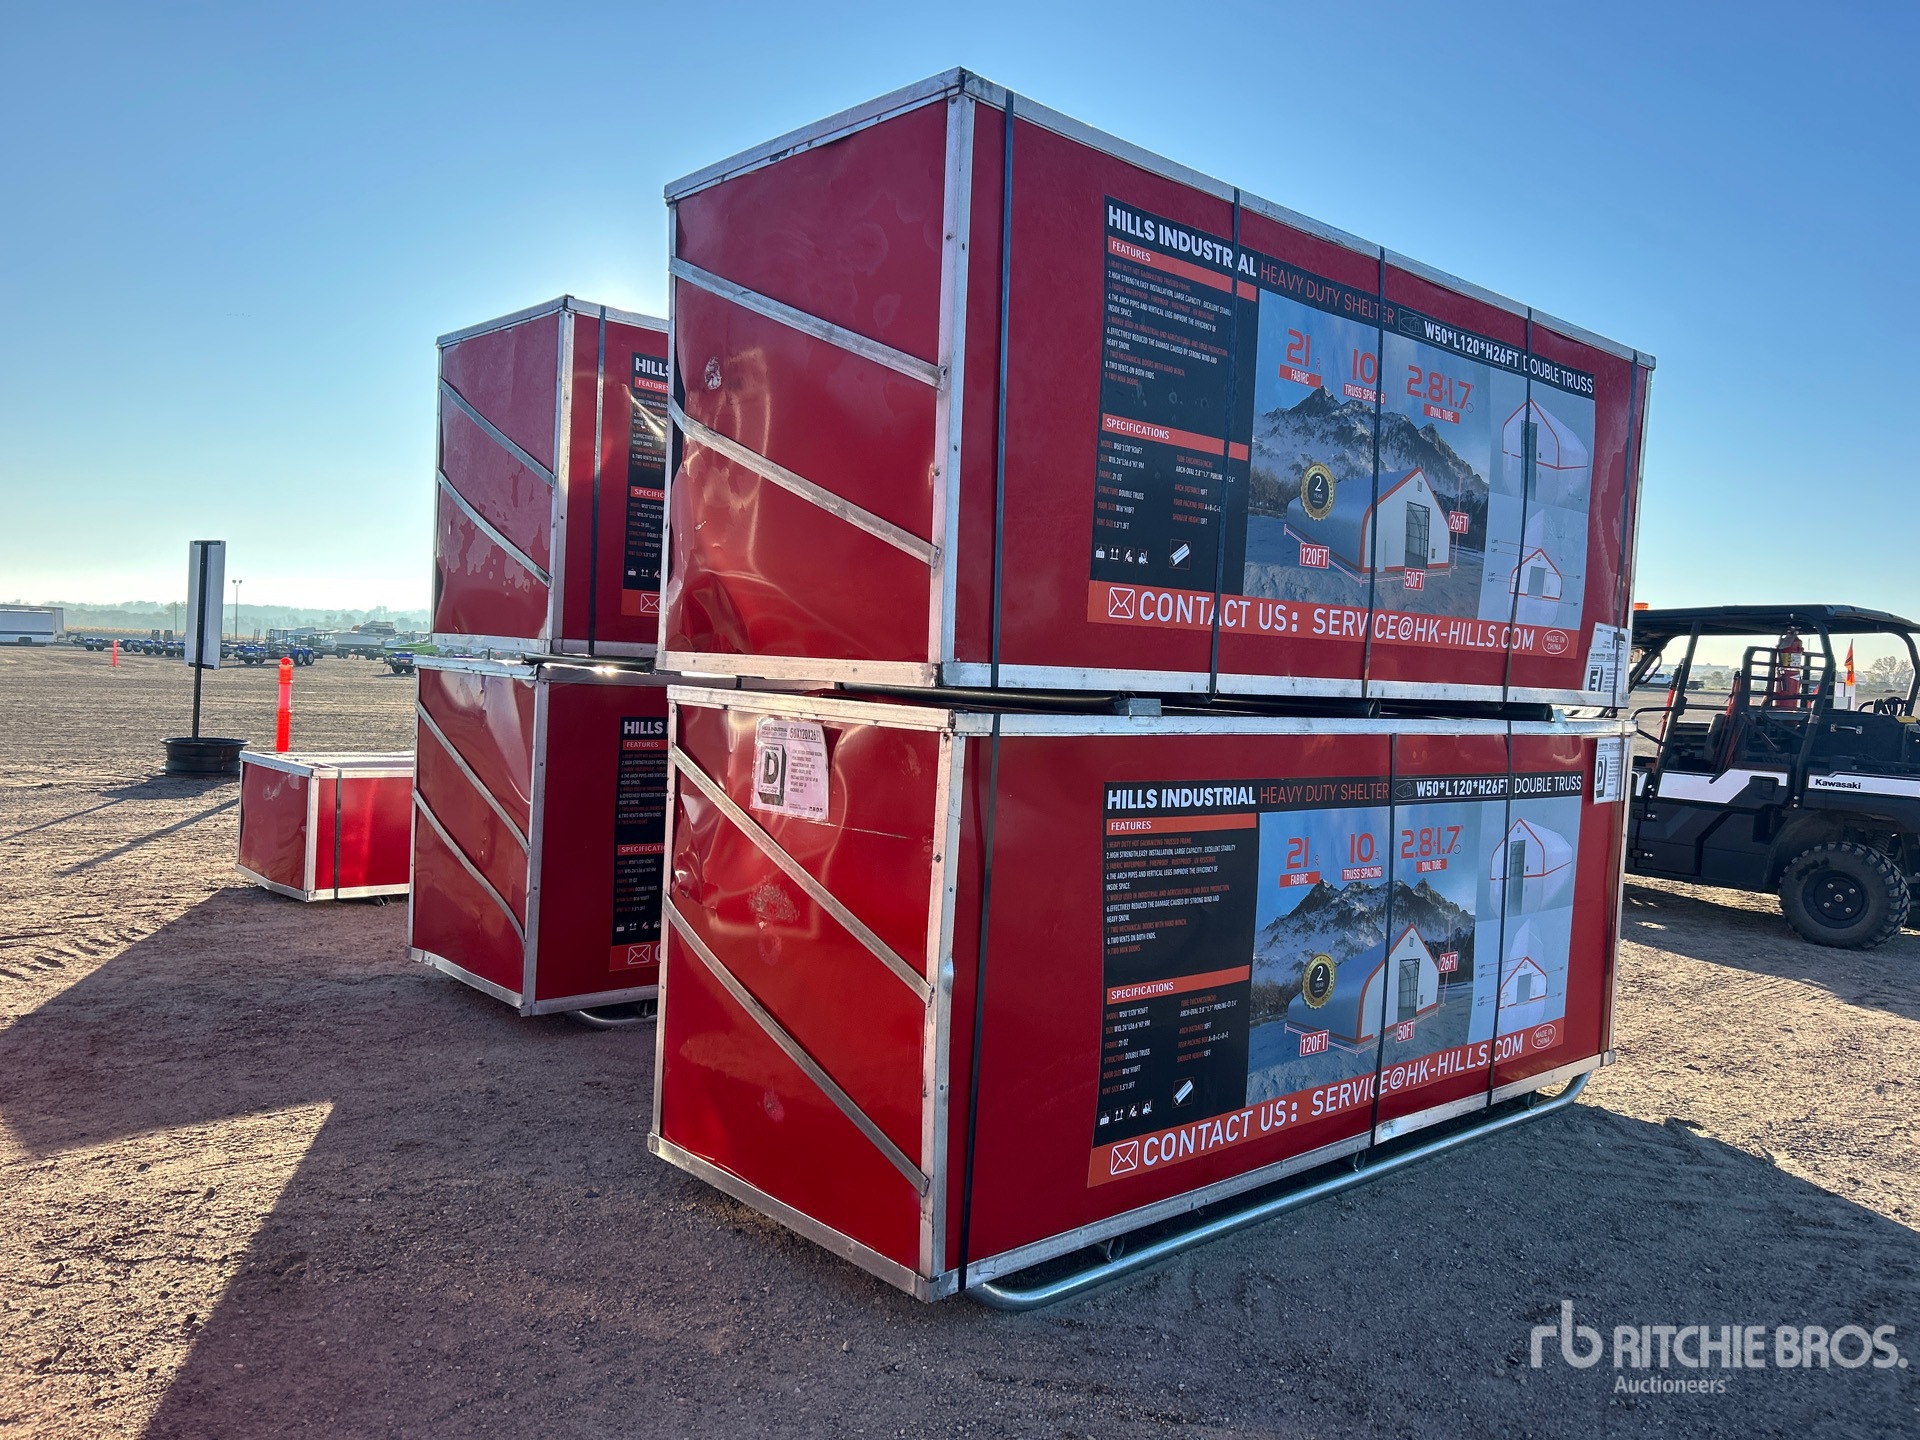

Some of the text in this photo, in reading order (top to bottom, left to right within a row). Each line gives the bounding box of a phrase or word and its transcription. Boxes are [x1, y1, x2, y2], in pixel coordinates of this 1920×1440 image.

[1112, 240, 1150, 262] FEATURES
[1107, 303, 1120, 313] INSIDE
[1108, 205, 1155, 241] HILLS
[1158, 223, 1257, 277] INDUSTRAL
[1260, 261, 1303, 294] HEAVY
[1306, 278, 1340, 308] DUTY
[1560, 368, 1593, 394] TRUSS
[1119, 296, 1129, 305] ARCH
[1129, 299, 1139, 308] PIPES
[1147, 305, 1163, 316] VERTICAL
[1173, 313, 1187, 323] IMPROVE
[1106, 337, 1117, 347] HEAVY
[1132, 333, 1148, 344] REDUCED
[1155, 340, 1169, 350] DAMAGE
[1170, 344, 1182, 354] CAUSED
[1188, 350, 1201, 359] STRONG
[1286, 327, 1310, 367] 21
[1117, 363, 1128, 373] VENTS
[1128, 366, 1134, 374] ON
[1135, 368, 1144, 377] BOTH
[1352, 347, 1378, 386] 10
[1291, 369, 1309, 384] FABIRC
[1344, 383, 1384, 404] TRUSS SPACG
[1430, 405, 1453, 422] OVAL TUBE
[1106, 418, 1169, 440] SPECIFICATIONS
[1315, 475, 1322, 491] 2
[1450, 513, 1467, 532] 26FT
[1301, 546, 1327, 566] 120FT
[1405, 571, 1423, 588] 50FT
[1138, 590, 1534, 651] CONTACT US: SERVCE@HK-HILLS.COM
[1547, 642, 1561, 650] CHINA
[624, 721, 664, 735] HILLS
[763, 751, 779, 784] D
[1107, 789, 1157, 809] HILLS
[1161, 786, 1256, 808] INDUSTRIAL
[1259, 785, 1303, 804] HEAVY
[1306, 784, 1337, 801] DUTY
[1340, 783, 1389, 800] SHELTER
[1514, 777, 1551, 793] DOUBLE
[1553, 775, 1581, 791] TRUSS
[1815, 778, 1861, 789] Kawasaki
[1111, 820, 1151, 831] FEATURES
[621, 844, 665, 853] SPECIFICATI
[1286, 837, 1309, 869] 21
[1349, 832, 1375, 864] 10
[1146, 869, 1163, 877] VERTICAL
[1173, 867, 1188, 875] IMPROVE
[1290, 873, 1308, 885] FABIRC
[1343, 866, 1381, 880] TRUSS SPACING
[1131, 901, 1147, 909] REDUCED
[1154, 899, 1169, 907] DAMAGE
[1119, 935, 1130, 943] VENTS
[1440, 953, 1457, 971] 26FT
[1316, 965, 1323, 981] 2
[1111, 980, 1173, 1000] SPECIFICATIONS
[1397, 1021, 1413, 1040] 50FT
[1535, 1027, 1552, 1039] MADE IN
[1301, 1032, 1327, 1055] 120FT
[1536, 1036, 1550, 1045] CHINA
[1142, 1032, 1523, 1167] CONTACT US: SERVICE@HK-HILLS.COM
